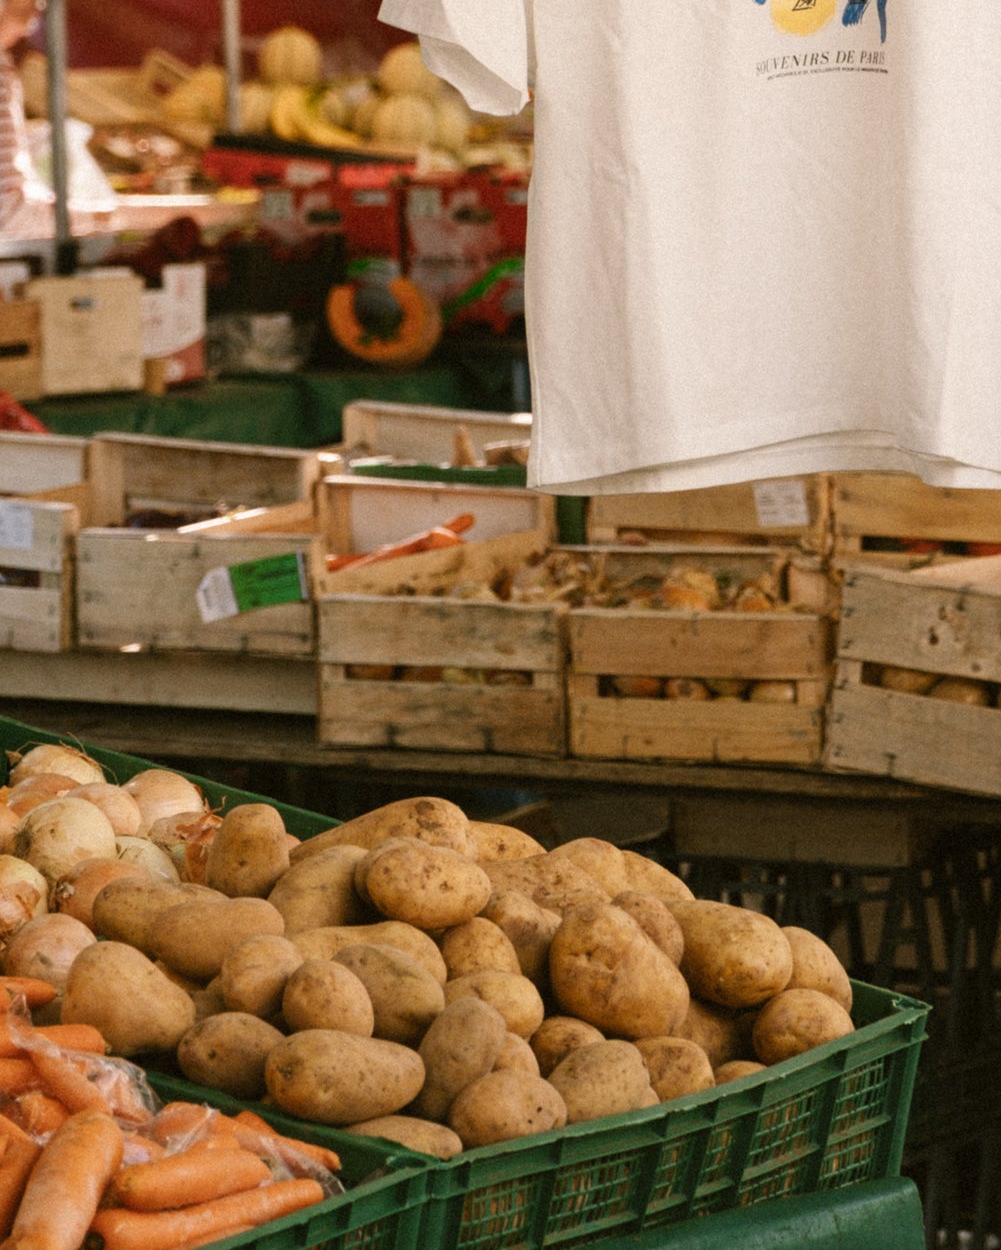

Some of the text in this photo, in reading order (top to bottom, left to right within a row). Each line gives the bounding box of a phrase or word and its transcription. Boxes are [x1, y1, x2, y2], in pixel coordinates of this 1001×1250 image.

[756, 51, 830, 76] SOUVENIRS
[835, 50, 856, 64] DE
[859, 50, 886, 66] PARIS
